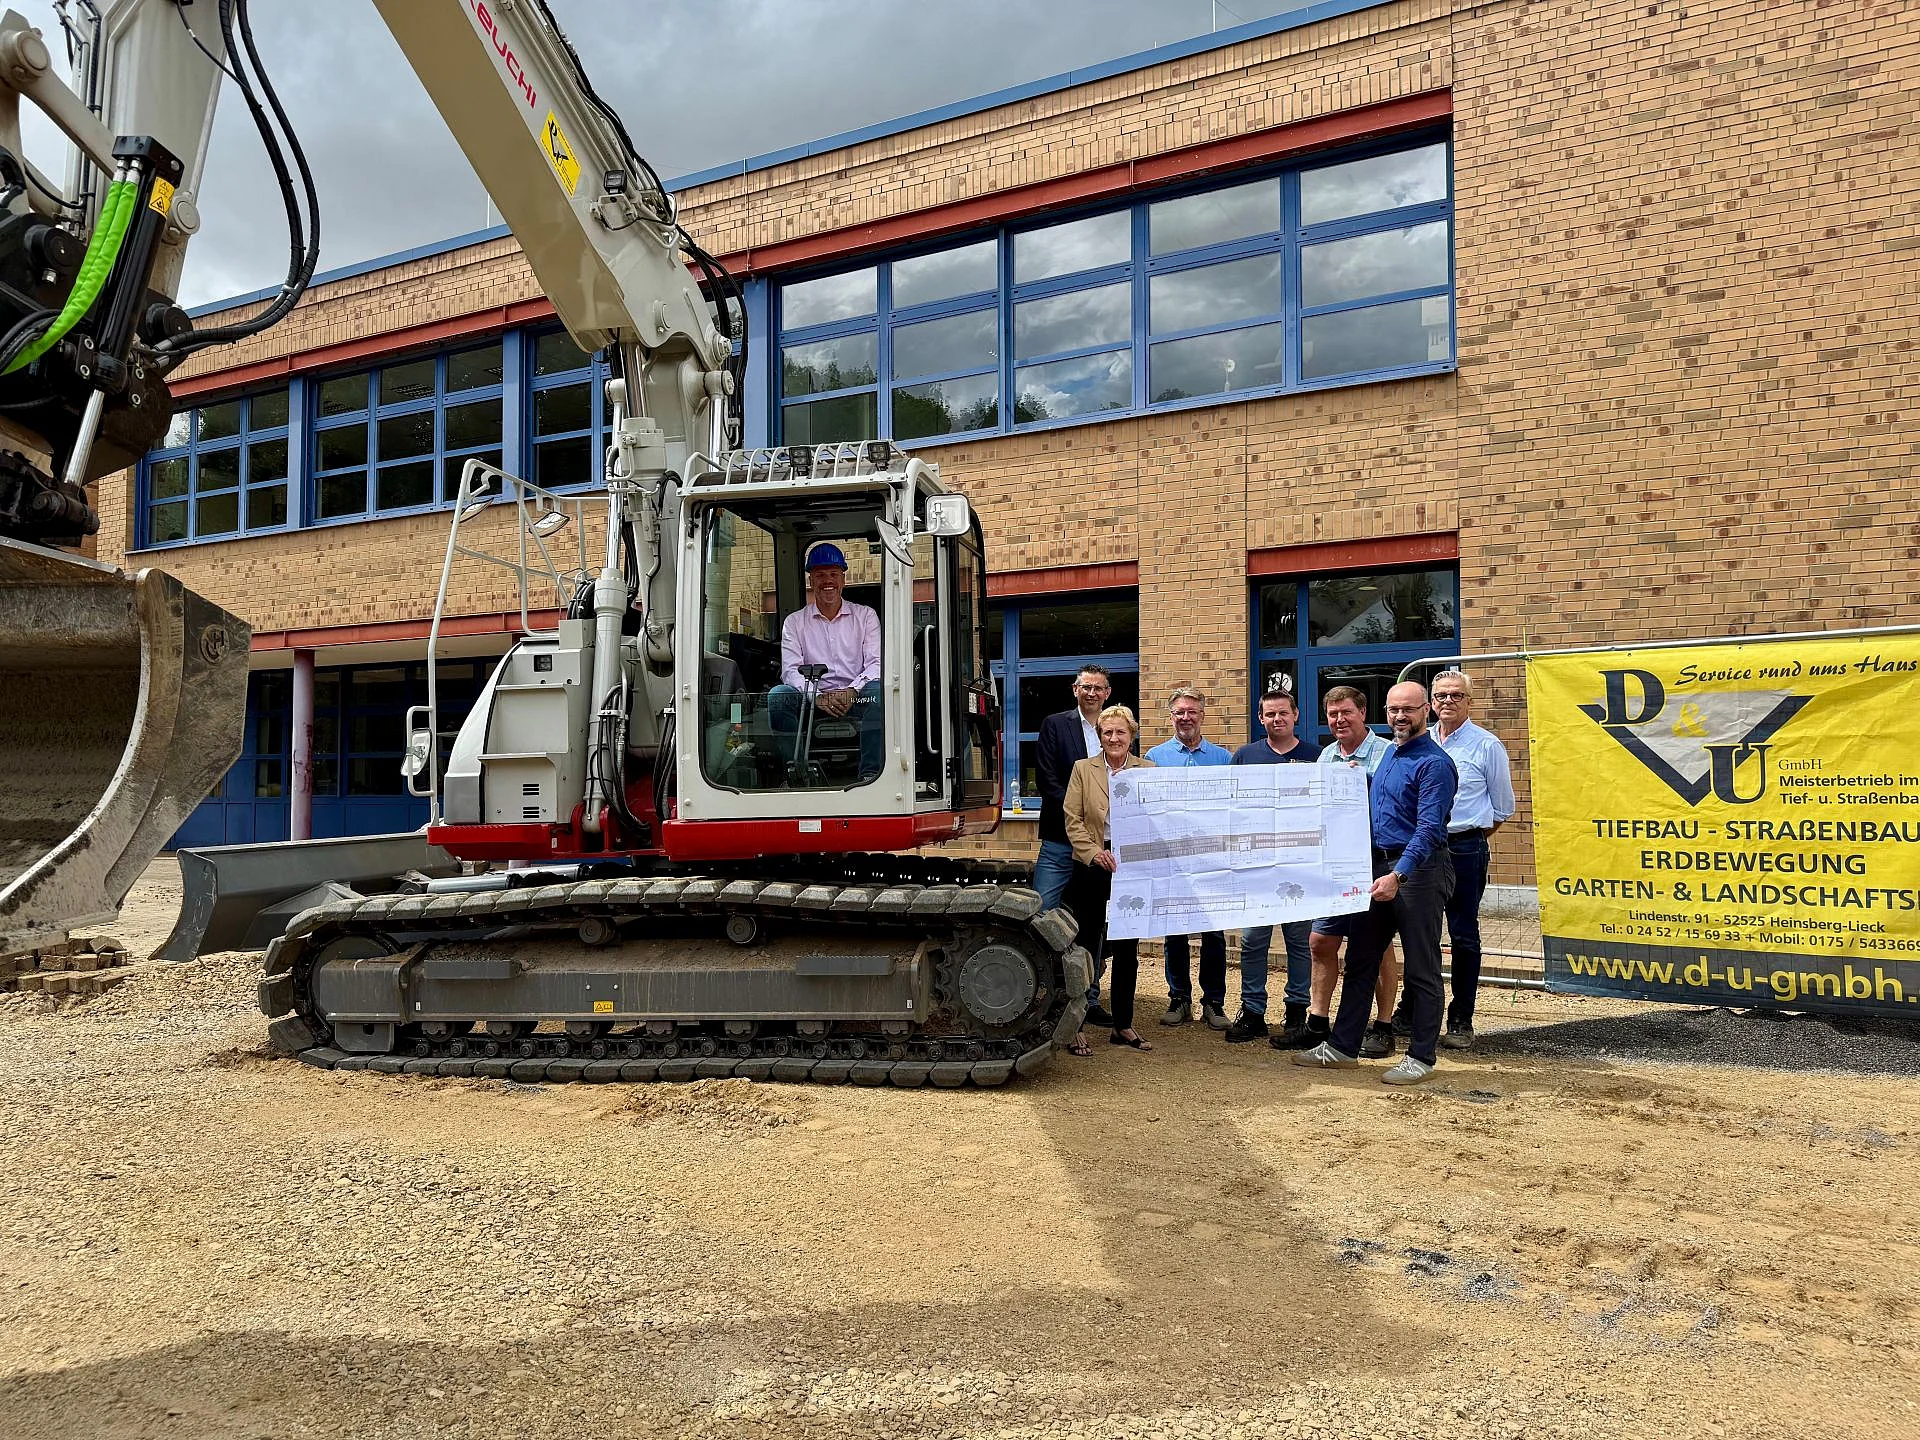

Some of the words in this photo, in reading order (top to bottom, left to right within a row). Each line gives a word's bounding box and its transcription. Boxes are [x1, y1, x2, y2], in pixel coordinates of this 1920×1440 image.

[1674, 664, 1752, 686] Service
[1758, 660, 1802, 679] rund
[1808, 663, 1847, 676] ums
[1853, 654, 1918, 674] Haus
[1598, 669, 1665, 726] D
[1778, 758, 1823, 771] GmbH
[1779, 773, 1894, 788] Meisterbetrieb
[1899, 773, 1919, 786] im
[1780, 793, 1814, 805] Tief-
[1818, 795, 1832, 805] u.
[1592, 819, 1700, 840] TIEFBAU
[1725, 819, 1920, 843] STRAßENBAU
[1640, 850, 1866, 875] ERDBEWEGUNG
[1554, 877, 1665, 900] GARTEN-
[1672, 881, 1693, 902] &
[1701, 882, 1920, 911] LANDSCHAFTS
[1629, 910, 1691, 923] Lindenstr.
[1694, 913, 1710, 924] 91
[1723, 915, 1765, 927] 52525
[1770, 916, 1886, 934] Heinsberg-Lieck
[1600, 923, 1623, 935] Tel.:
[1626, 925, 1634, 935] 0
[1637, 926, 1653, 937] 24
[1656, 927, 1672, 938] 52
[1685, 929, 1700, 939] 15
[1704, 930, 1720, 941] 69
[1724, 930, 1741, 942] 33
[1759, 932, 1805, 946] Mobil:
[1808, 935, 1844, 948] 0175
